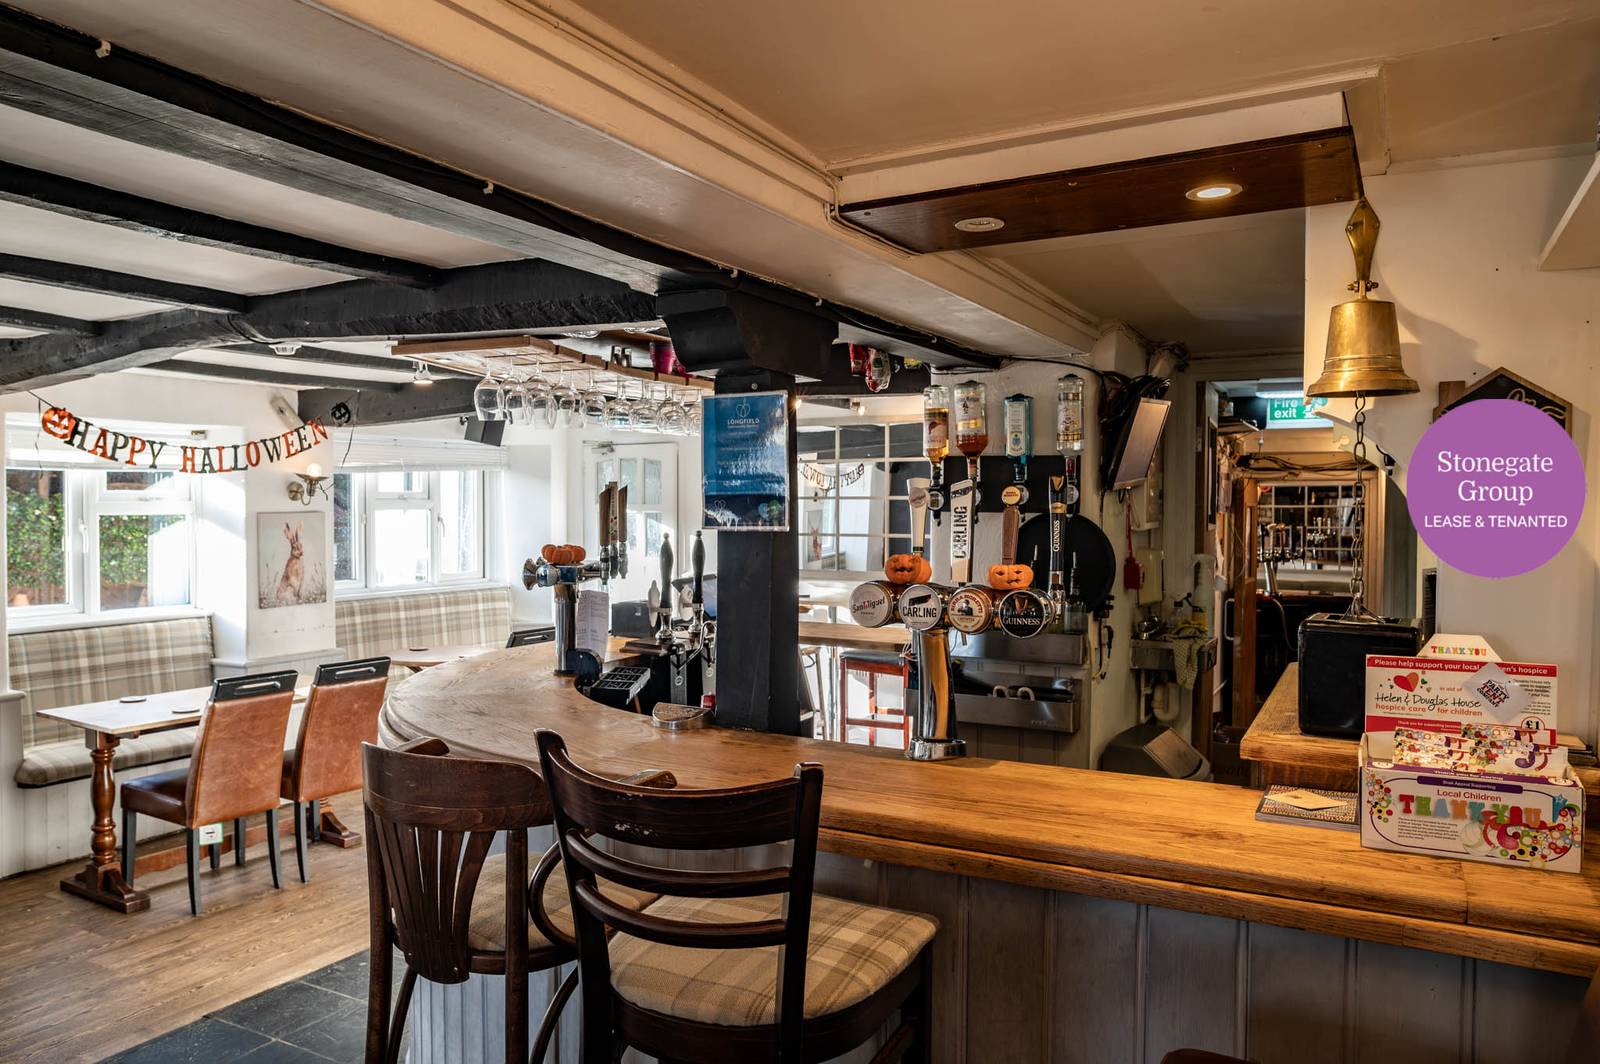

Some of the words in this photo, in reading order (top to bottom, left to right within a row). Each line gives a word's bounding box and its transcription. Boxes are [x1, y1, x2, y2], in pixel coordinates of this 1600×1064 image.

[1274, 399, 1298, 408] Fire
[1274, 408, 1297, 418] exit
[65, 416, 167, 469] HAPPY
[180, 415, 329, 473] HALLOWEEN
[952, 506, 968, 559] CARLING
[1052, 520, 1060, 552] GUINNESS
[902, 606, 937, 618] CARLING
[1002, 616, 1041, 626] GUINNESS
[1431, 646, 1465, 655] THANK
[1468, 647, 1488, 656] YOU
[1398, 660, 1414, 668] help
[1415, 661, 1443, 670] support
[1444, 663, 1461, 671] your
[1462, 662, 1479, 670] local
[1518, 667, 1547, 675] hospice
[1480, 683, 1505, 704] TENT
[1486, 679, 1510, 700] PARTY
[1375, 692, 1402, 703] Helen
[1404, 694, 1411, 706] &
[1413, 694, 1448, 711] Douglas
[1451, 698, 1482, 709] House
[1476, 687, 1499, 708] COMPANY
[1375, 703, 1405, 712] hospice
[1437, 706, 1448, 714] for
[1450, 707, 1482, 717] children
[1525, 720, 1540, 730] £1
[1437, 789, 1461, 798] Local
[1463, 791, 1502, 802] Children
[1399, 794, 1485, 820] THANK
[1491, 803, 1542, 828] YOU
